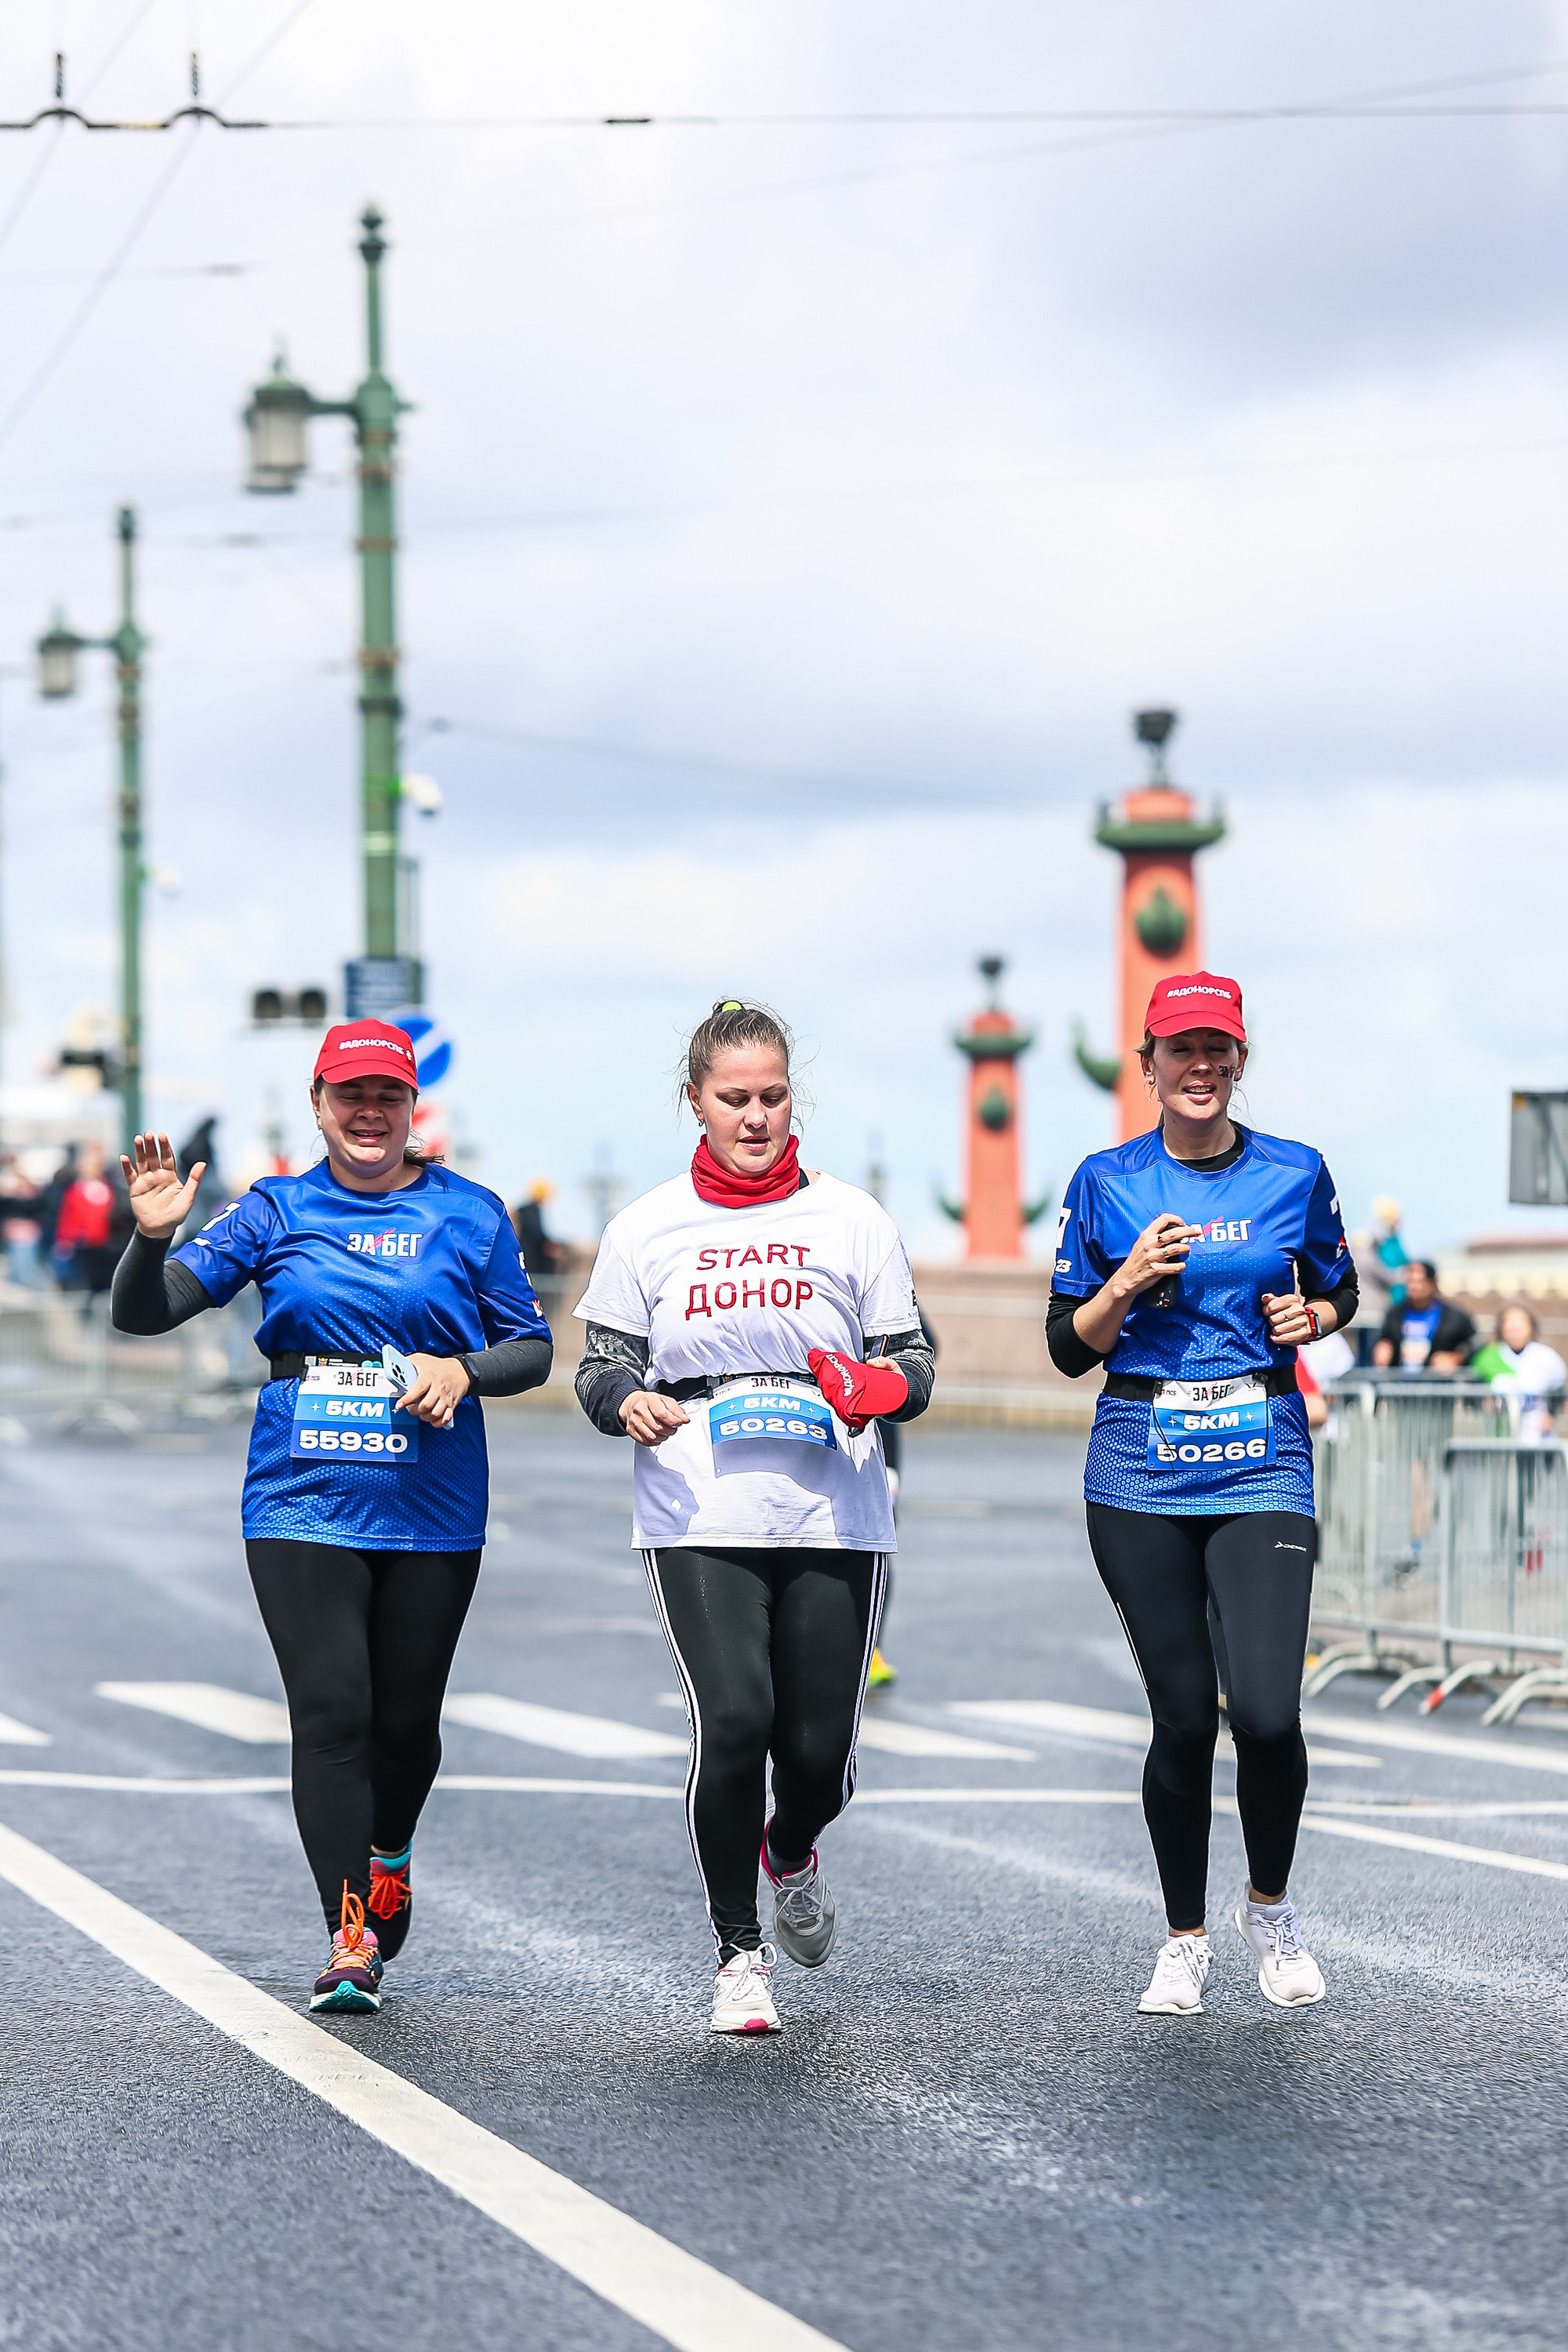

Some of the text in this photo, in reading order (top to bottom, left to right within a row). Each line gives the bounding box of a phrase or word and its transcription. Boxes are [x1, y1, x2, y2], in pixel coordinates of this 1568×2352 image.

[696, 1243, 811, 1271] START
[685, 1278, 813, 1320] ДОНОР
[299, 1428, 408, 1454] 55930
[719, 1417, 828, 1440] 50263
[1156, 1438, 1266, 1463] 50266
